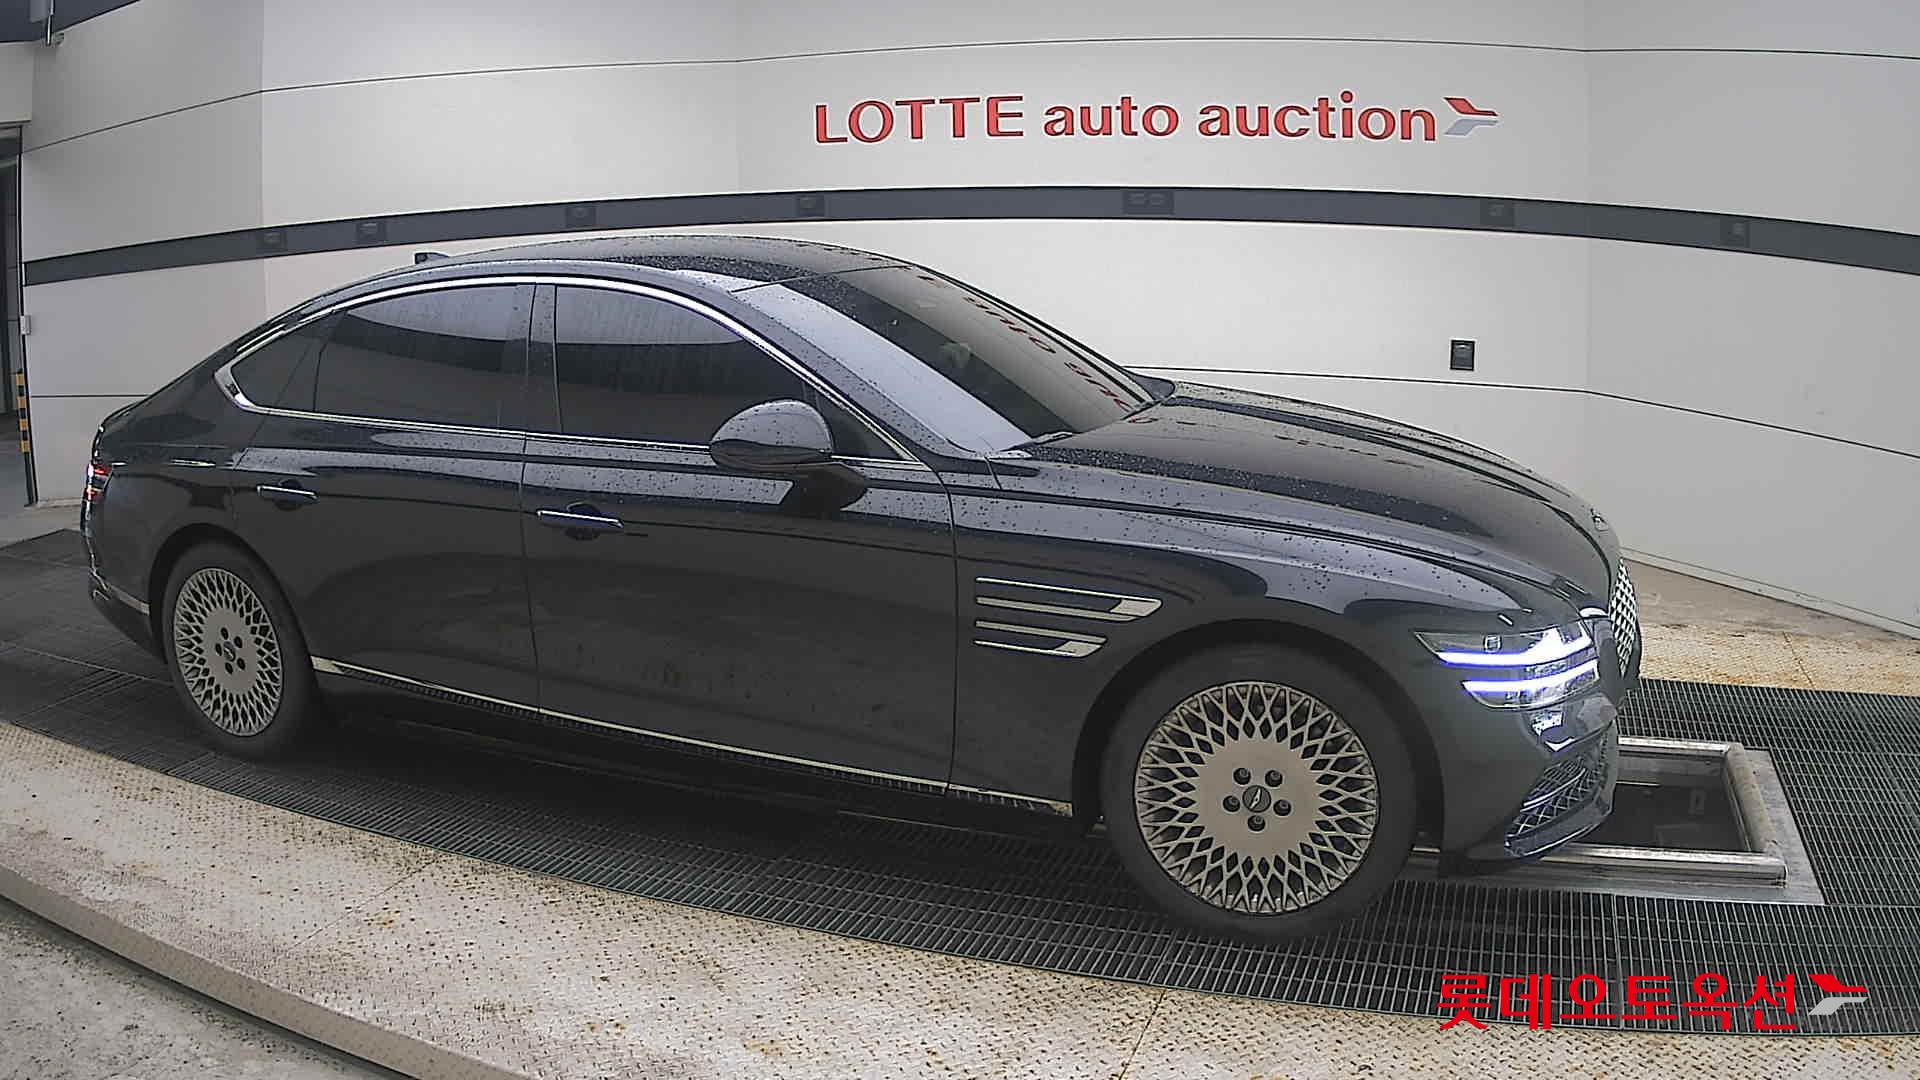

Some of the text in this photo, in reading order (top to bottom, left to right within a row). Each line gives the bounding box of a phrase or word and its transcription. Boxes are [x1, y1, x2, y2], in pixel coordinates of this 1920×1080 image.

[814, 91, 1437, 144] LOTTE auto auction
